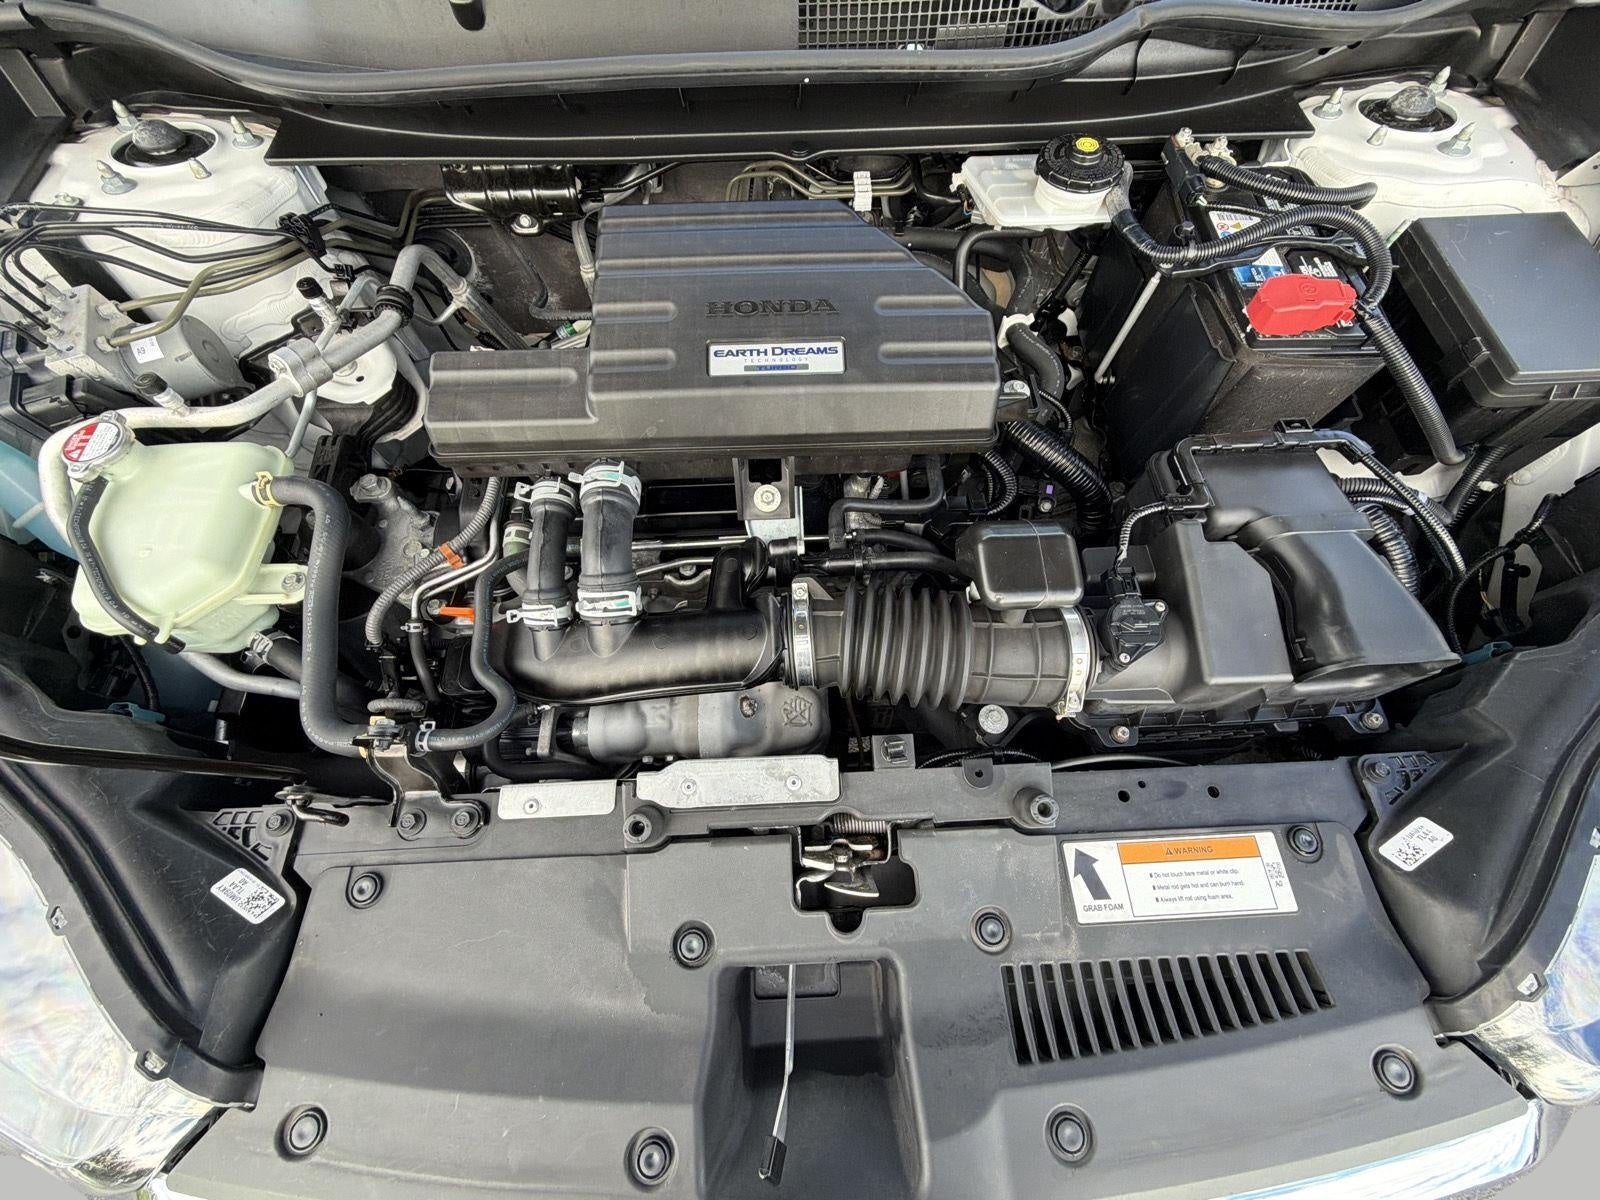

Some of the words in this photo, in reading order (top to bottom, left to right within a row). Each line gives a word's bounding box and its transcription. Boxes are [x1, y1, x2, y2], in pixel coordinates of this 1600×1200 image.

[706, 298, 840, 317] HONDA
[714, 348, 768, 358] EARTH
[772, 346, 838, 357] DREAMS
[1174, 846, 1214, 855] WARNING
[1083, 904, 1102, 913] GRAB
[1104, 903, 1125, 911] FOAM
